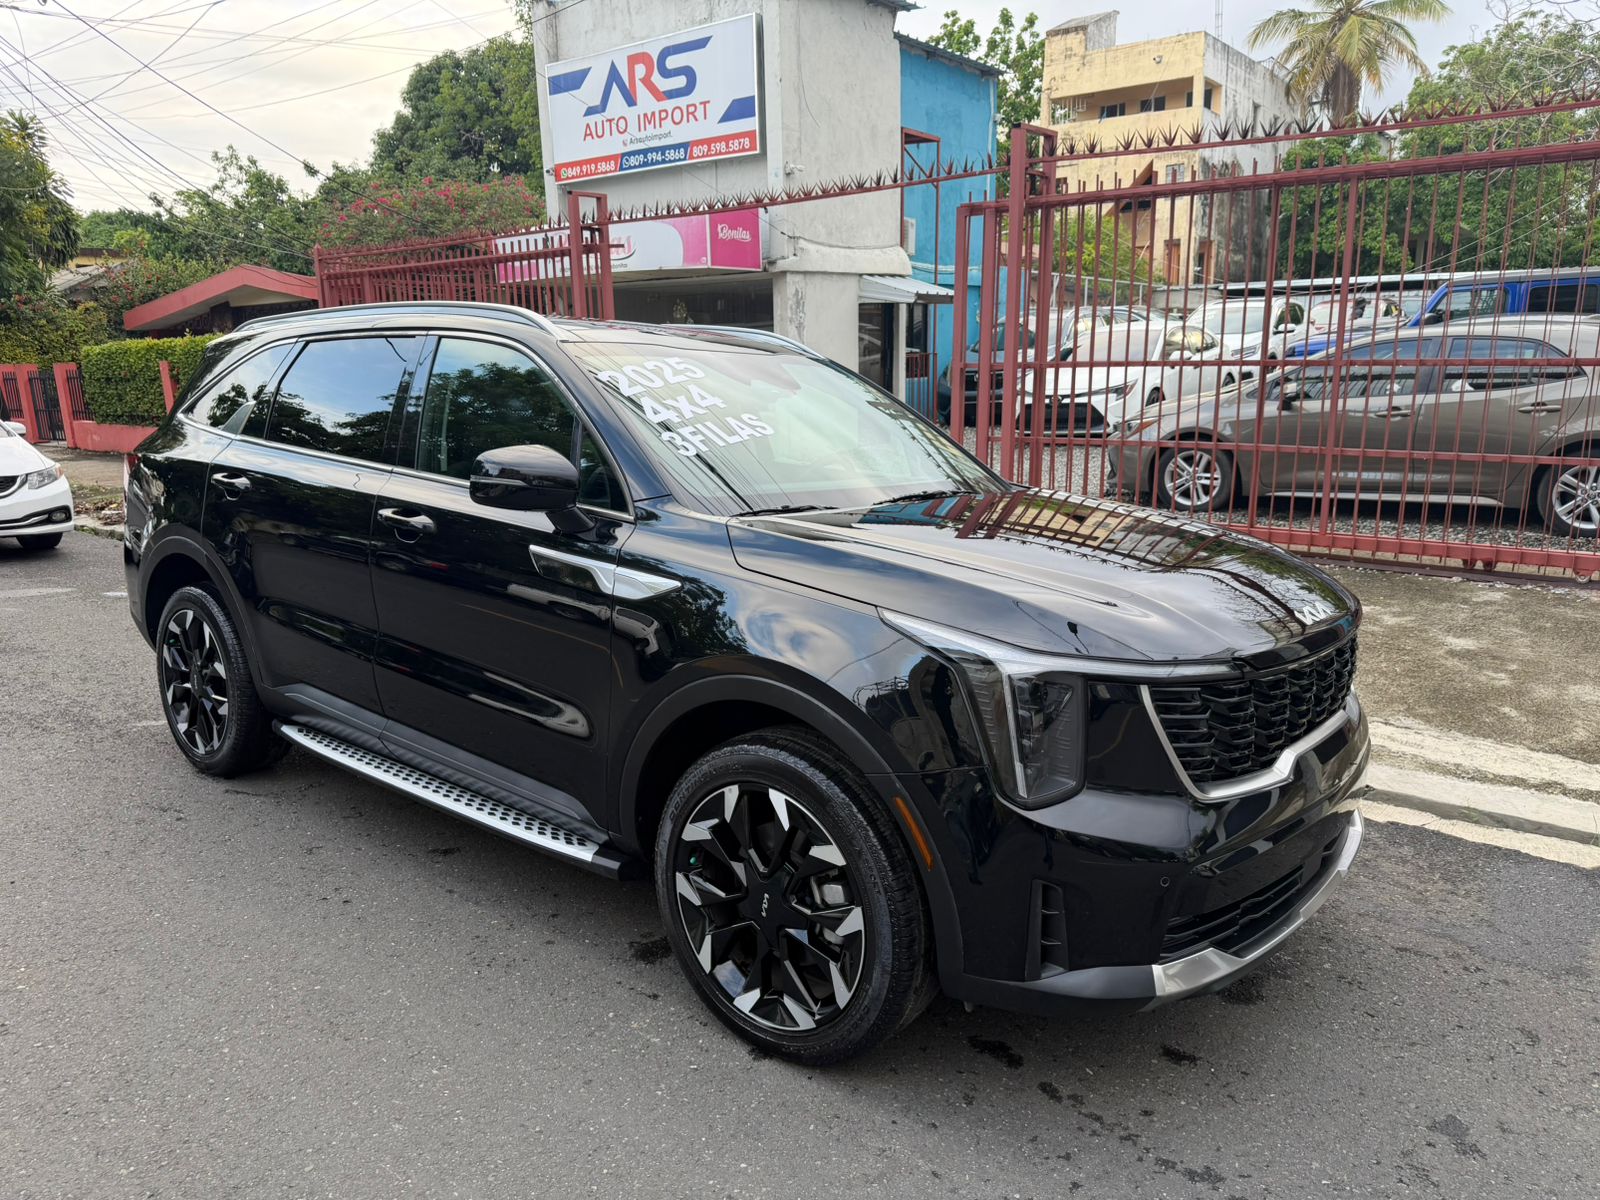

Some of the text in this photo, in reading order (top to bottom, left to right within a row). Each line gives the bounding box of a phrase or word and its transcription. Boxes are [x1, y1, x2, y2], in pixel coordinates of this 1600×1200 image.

[583, 35, 714, 117] ARS
[583, 100, 711, 142] AUTO IMPORT
[567, 137, 751, 177] 849.919.5868 809-994-5868 809.598.5878
[717, 223, 752, 242] Bonitas
[598, 357, 705, 396] 2025
